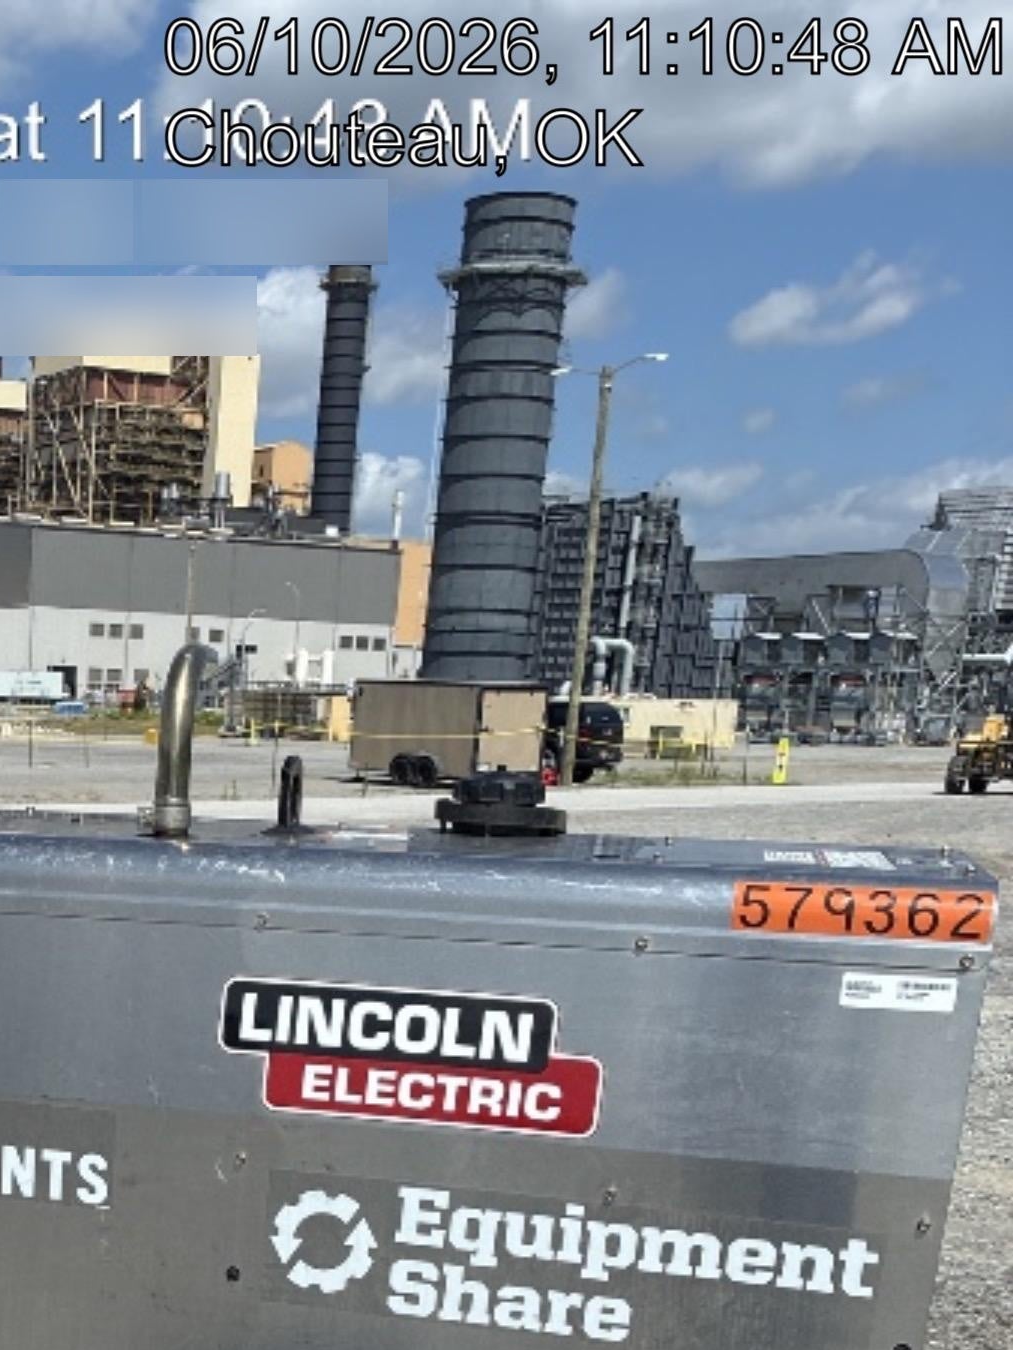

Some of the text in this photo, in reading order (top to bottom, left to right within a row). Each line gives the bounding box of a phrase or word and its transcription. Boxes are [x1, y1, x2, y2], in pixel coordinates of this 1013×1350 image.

[739, 884, 985, 940] 579362
[238, 992, 534, 1063] LINCOLN
[300, 1063, 563, 1121] ELECTRIC
[394, 1186, 880, 1298] Equipment
[386, 1258, 634, 1343] Share
